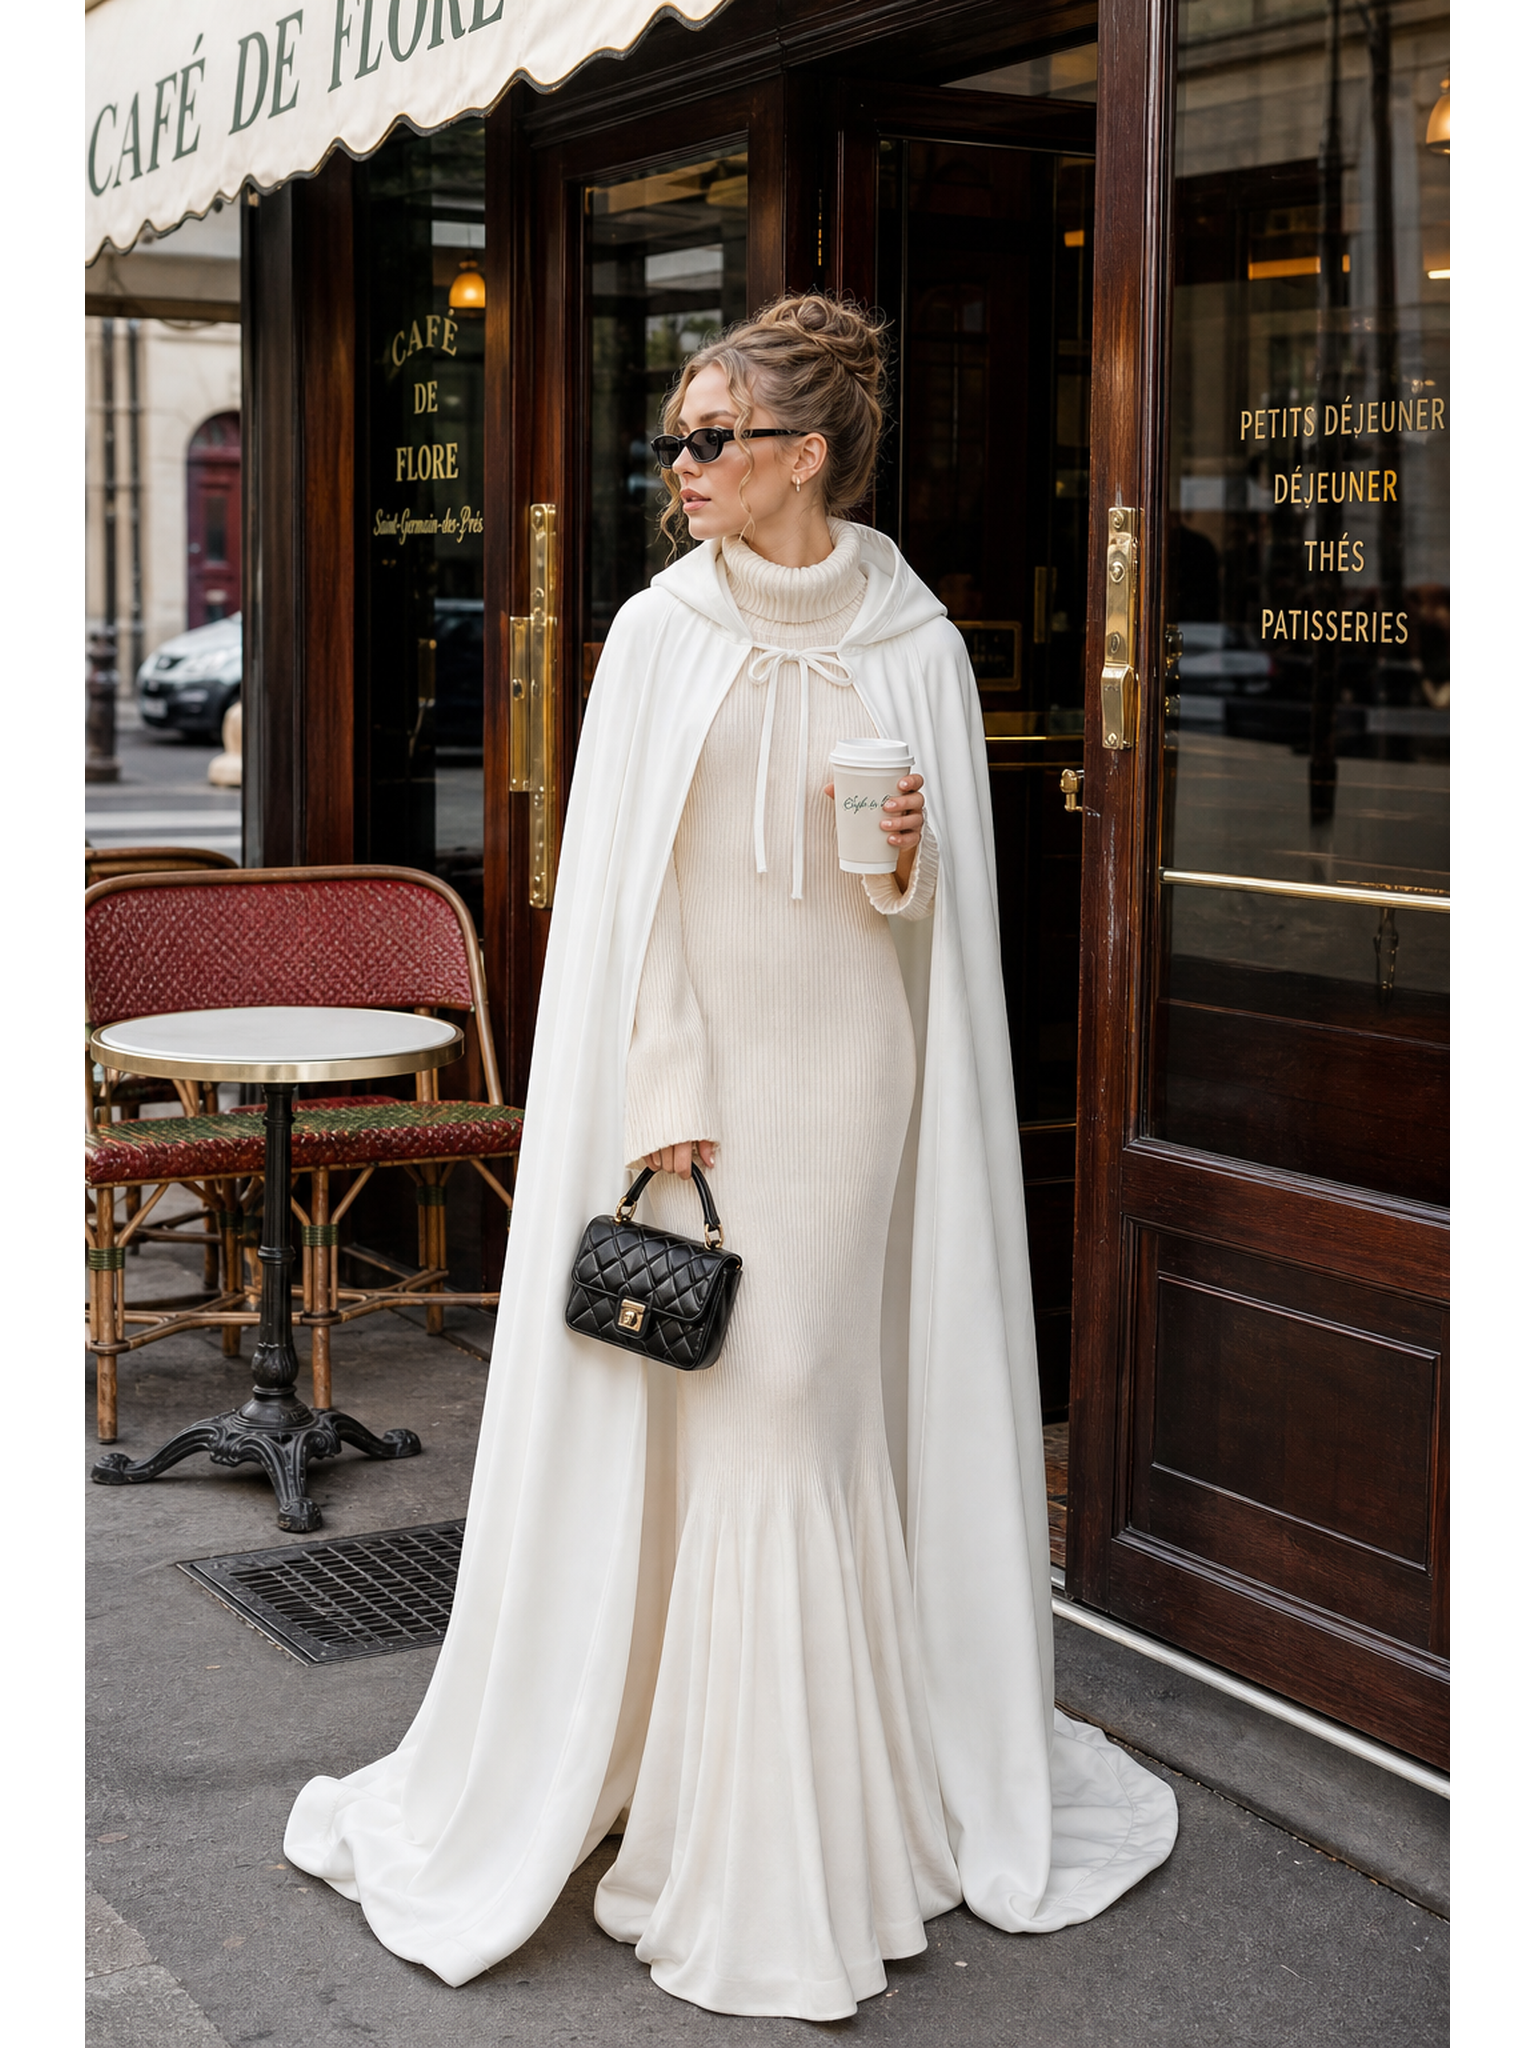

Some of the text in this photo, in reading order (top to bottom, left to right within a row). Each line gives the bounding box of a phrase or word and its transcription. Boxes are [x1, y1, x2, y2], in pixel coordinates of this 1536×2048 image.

[87, 33, 206, 197] CAFÉ
[228, 9, 303, 135] DE
[392, 308, 458, 366] CAFÉ
[414, 381, 438, 413] DE
[1240, 396, 1445, 440] PETITS DÉJEUNER
[396, 443, 458, 481] FLORE
[1274, 466, 1397, 508] DÉJEUNER
[1304, 532, 1364, 572] THÉS
[1262, 609, 1408, 644] PATISSERIES
